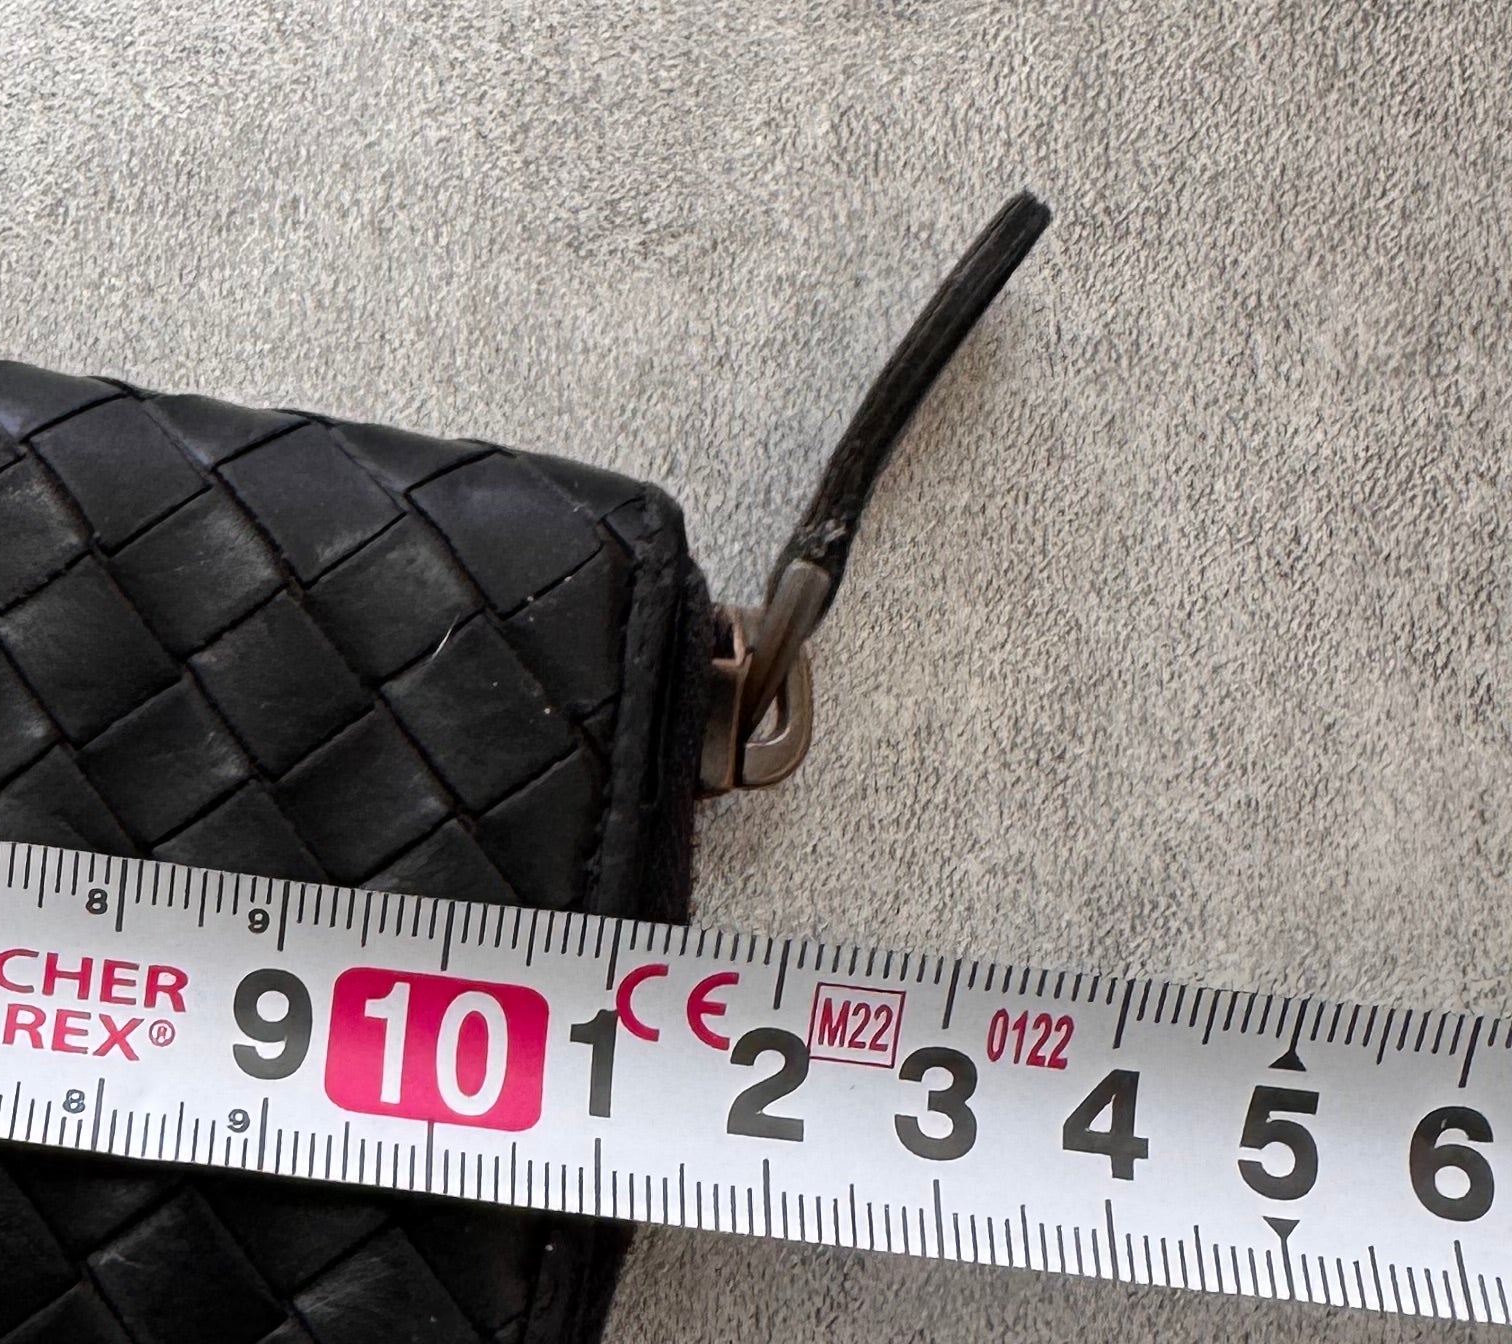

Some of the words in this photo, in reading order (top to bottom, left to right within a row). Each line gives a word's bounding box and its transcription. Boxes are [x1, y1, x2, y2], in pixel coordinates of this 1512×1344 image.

[85, 888, 108, 914] 8
[247, 908, 270, 934] 9
[616, 963, 740, 1051] CE
[817, 997, 895, 1053] M22
[988, 1007, 1076, 1070] 0122
[62, 1089, 86, 1114] 8
[227, 1108, 251, 1133] 9
[232, 967, 313, 1081] 9
[364, 981, 509, 1117] 10
[569, 1008, 619, 1118] 1
[726, 1026, 811, 1142] 2
[894, 1046, 979, 1162] 3
[1061, 1068, 1149, 1182] 4
[1237, 1084, 1320, 1201] 5
[1409, 1105, 1495, 1222] 6
